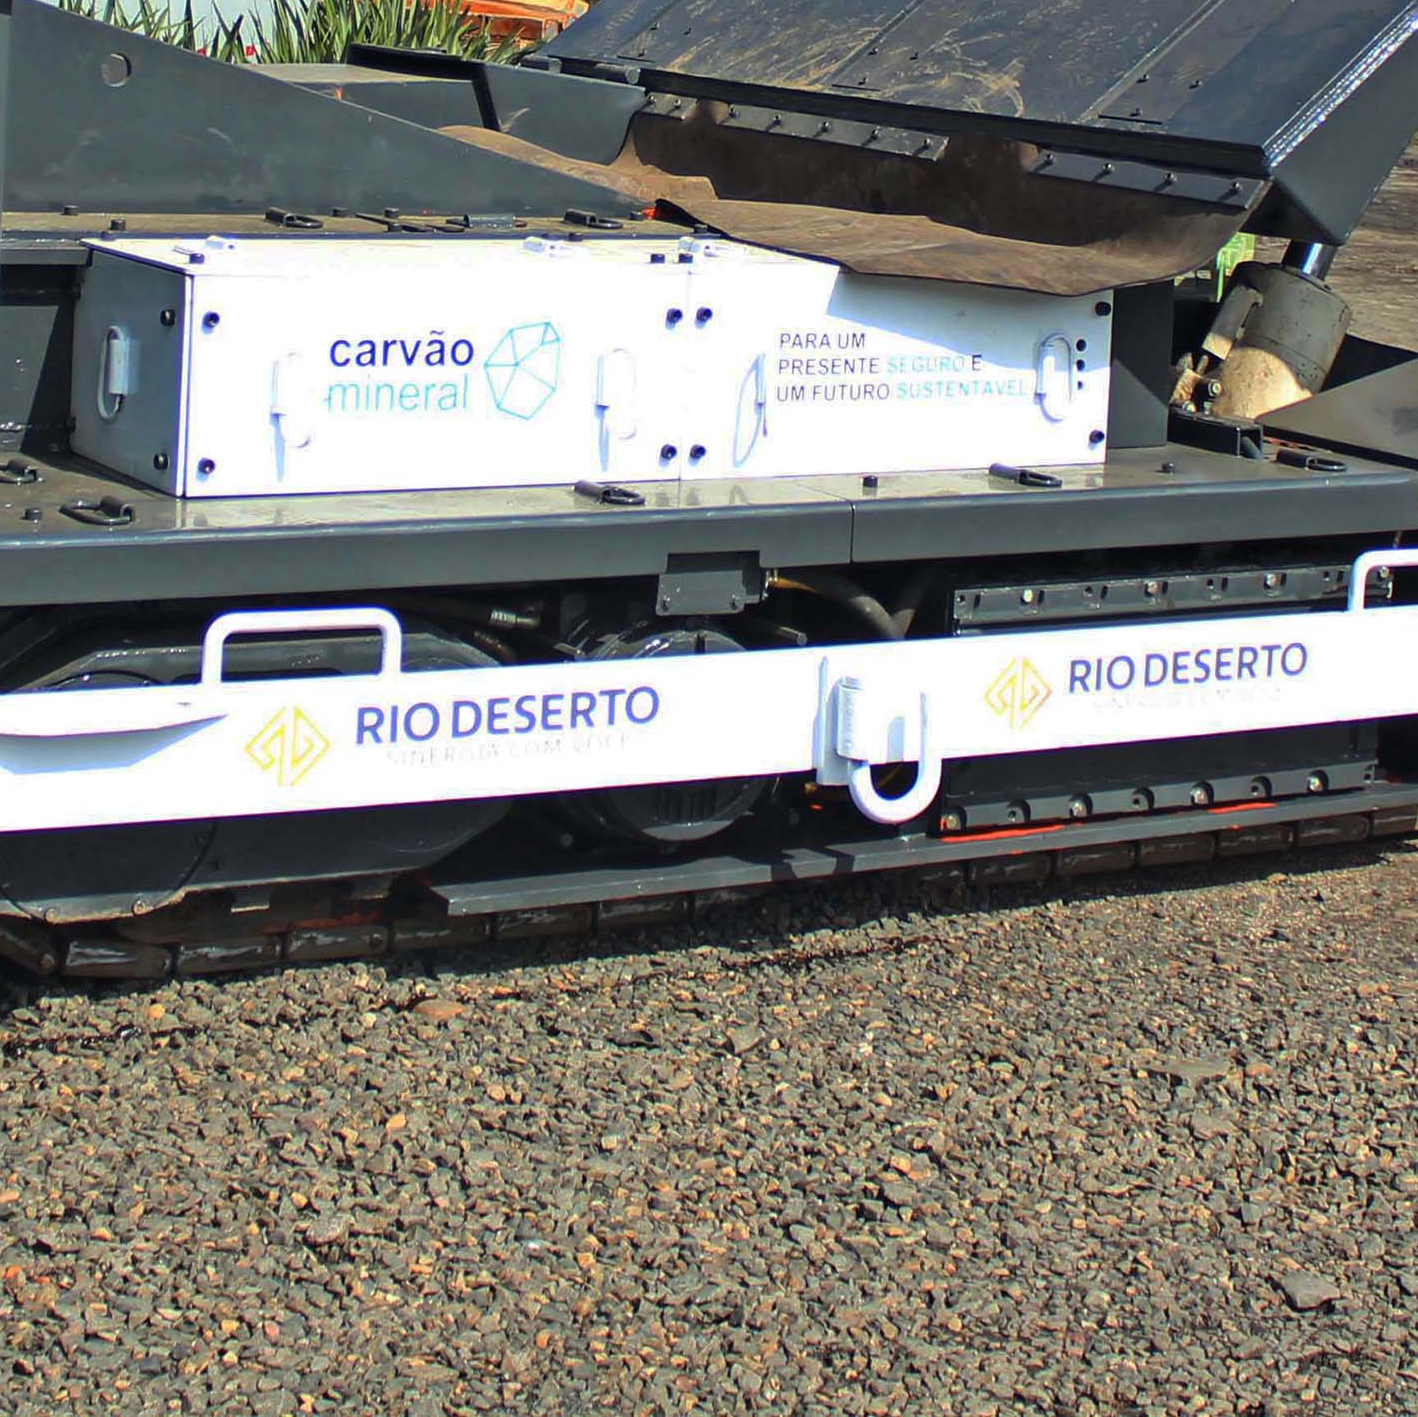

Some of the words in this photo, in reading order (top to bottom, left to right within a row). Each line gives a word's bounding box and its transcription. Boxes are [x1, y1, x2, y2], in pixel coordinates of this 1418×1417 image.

[329, 330, 474, 367] carvão
[779, 333, 830, 349] PARA
[838, 333, 865, 349] UM
[778, 358, 880, 375] PRESENTE
[887, 356, 965, 374] SEGURO
[971, 354, 982, 371] E
[328, 374, 469, 411] mineral
[776, 385, 805, 402] UM
[812, 383, 890, 401] FUTURO
[1069, 655, 1135, 693] RIO
[1144, 642, 1308, 688] DESERTO
[356, 702, 441, 745] RIO
[451, 686, 660, 738] DESERTO
